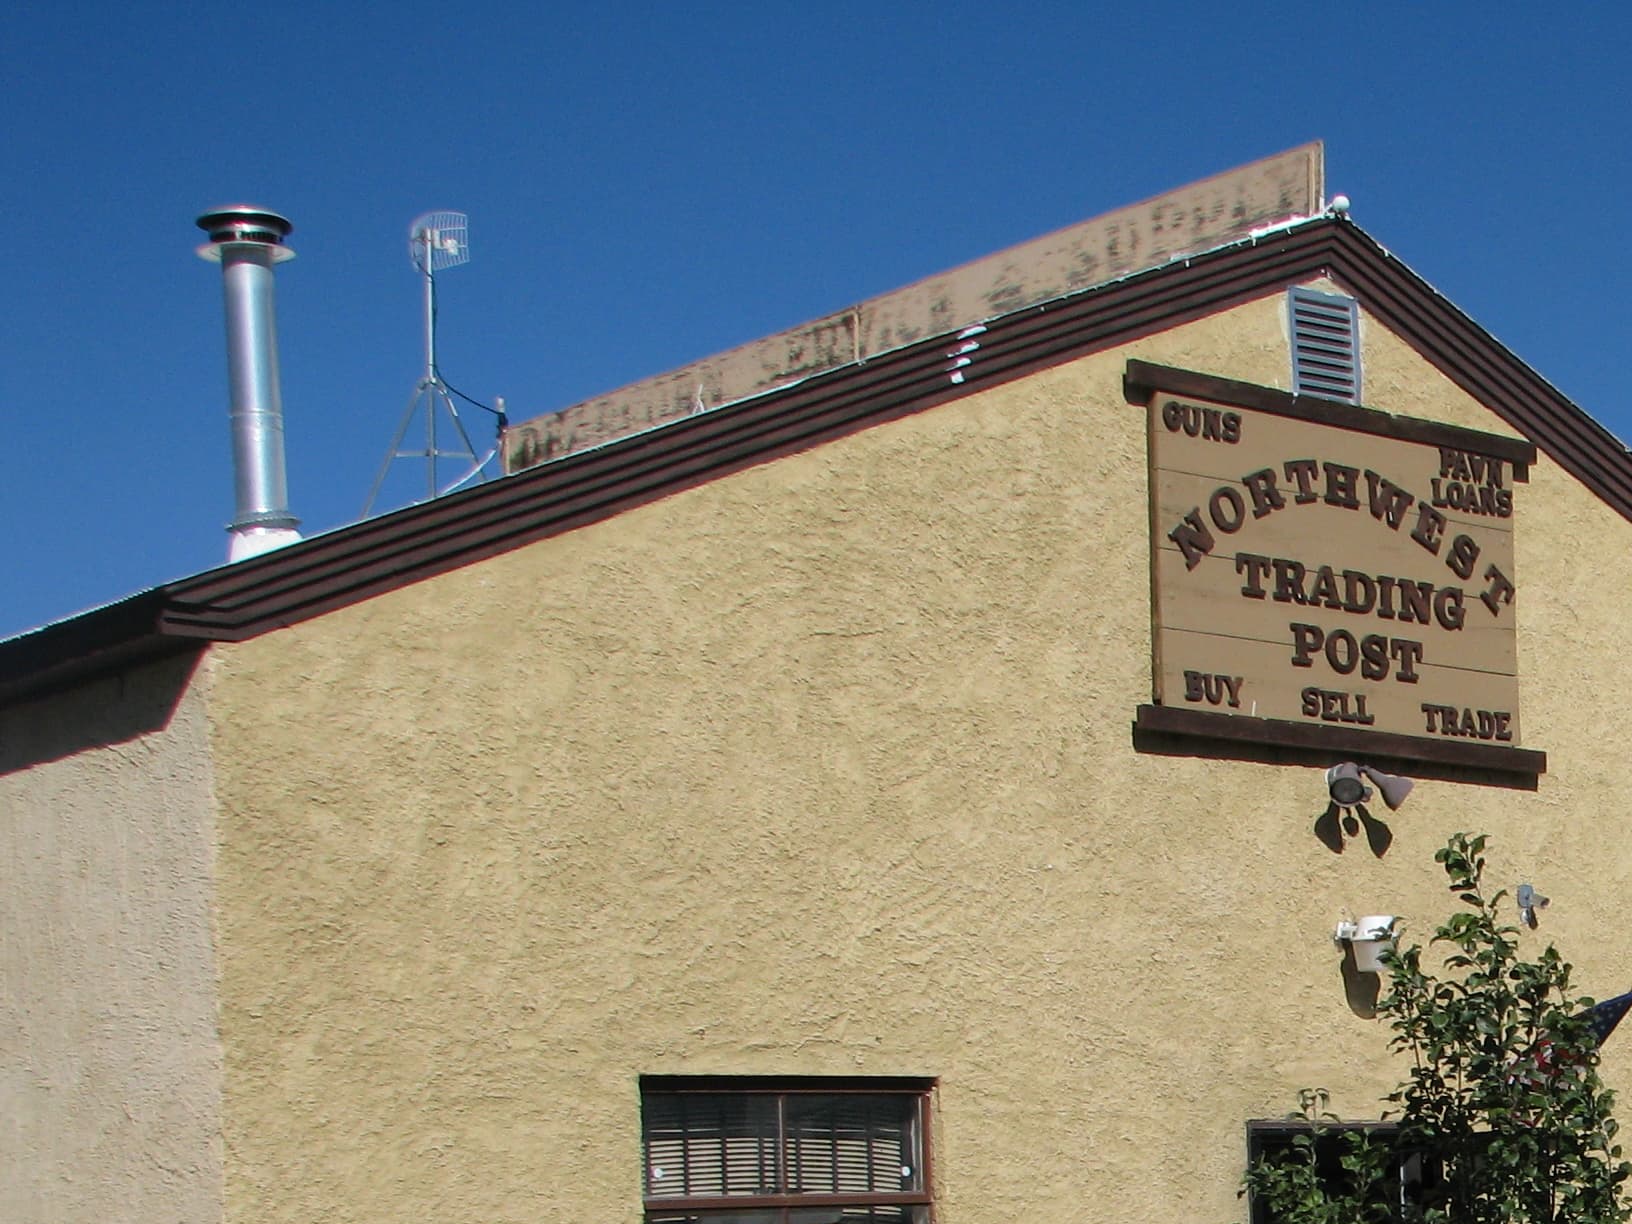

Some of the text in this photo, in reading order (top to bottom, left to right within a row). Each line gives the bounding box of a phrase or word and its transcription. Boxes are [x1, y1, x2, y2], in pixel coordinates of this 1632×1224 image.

[1162, 401, 1242, 444] GUNS
[1438, 446, 1504, 488] PAWN
[1430, 477, 1513, 518] LOANS
[1168, 459, 1515, 616] NORTHWEST
[1235, 552, 1465, 631] TRADING
[1290, 622, 1423, 684] POST
[1183, 670, 1244, 707] BUY
[1301, 686, 1375, 725] SELL
[1421, 703, 1513, 741] TRADE
